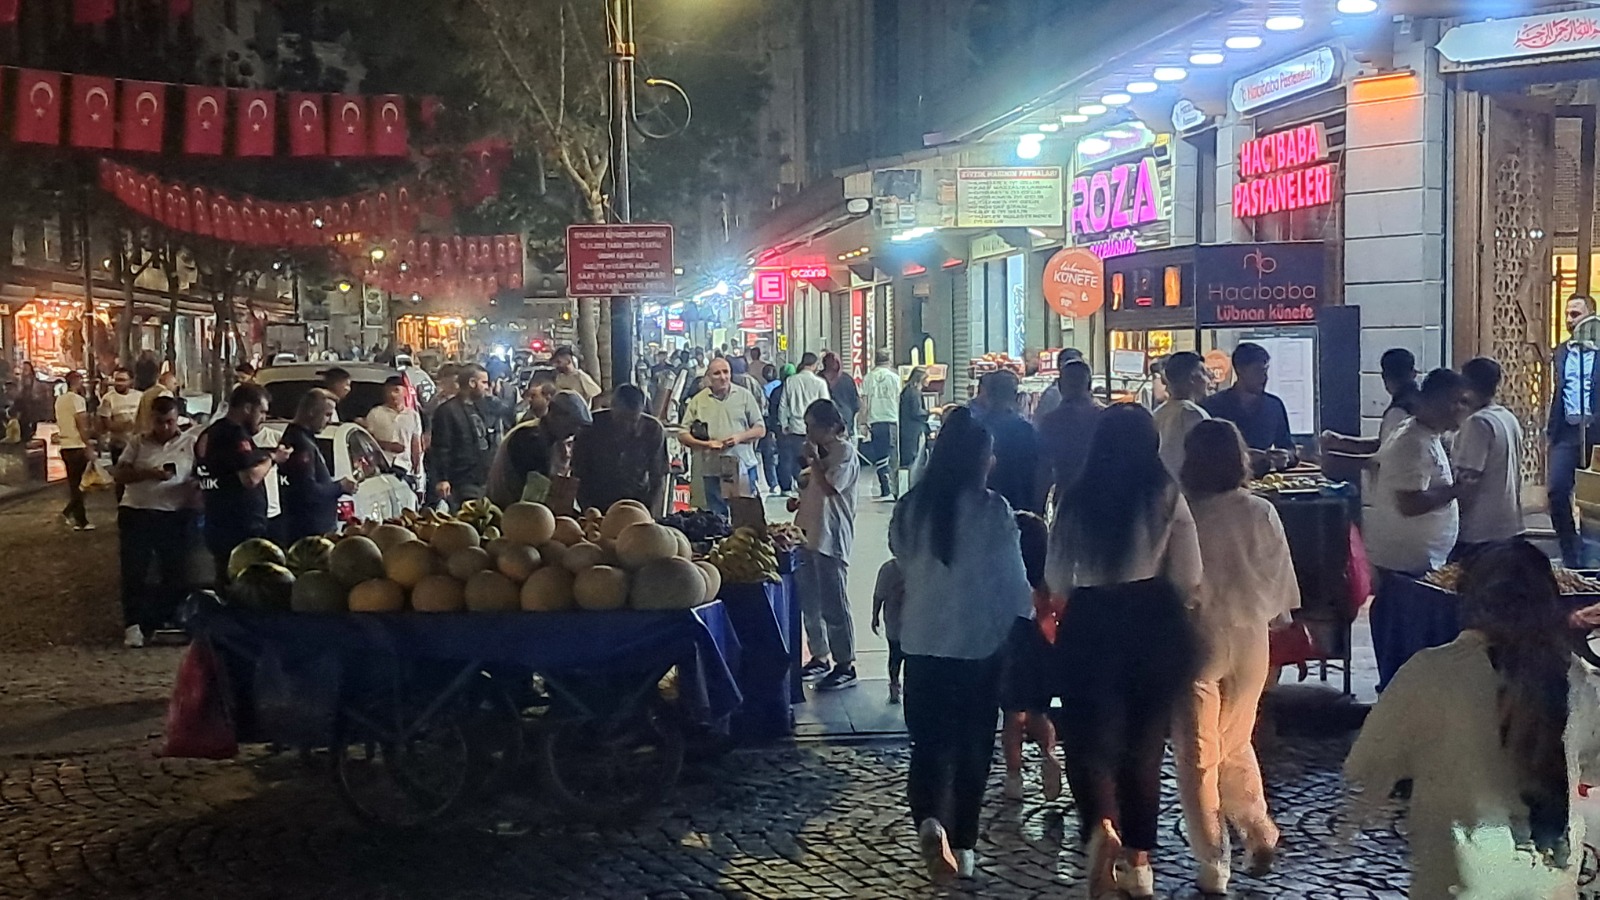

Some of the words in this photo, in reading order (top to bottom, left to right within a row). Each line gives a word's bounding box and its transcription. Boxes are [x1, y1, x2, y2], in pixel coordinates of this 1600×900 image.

[1071, 157, 1158, 235] ROZA
[762, 276, 779, 298] E
[1208, 281, 1316, 301] Hacıbaba
[1216, 304, 1265, 320] Lübnan
[1269, 303, 1315, 320] künefe
[852, 315, 863, 382] ECZA
